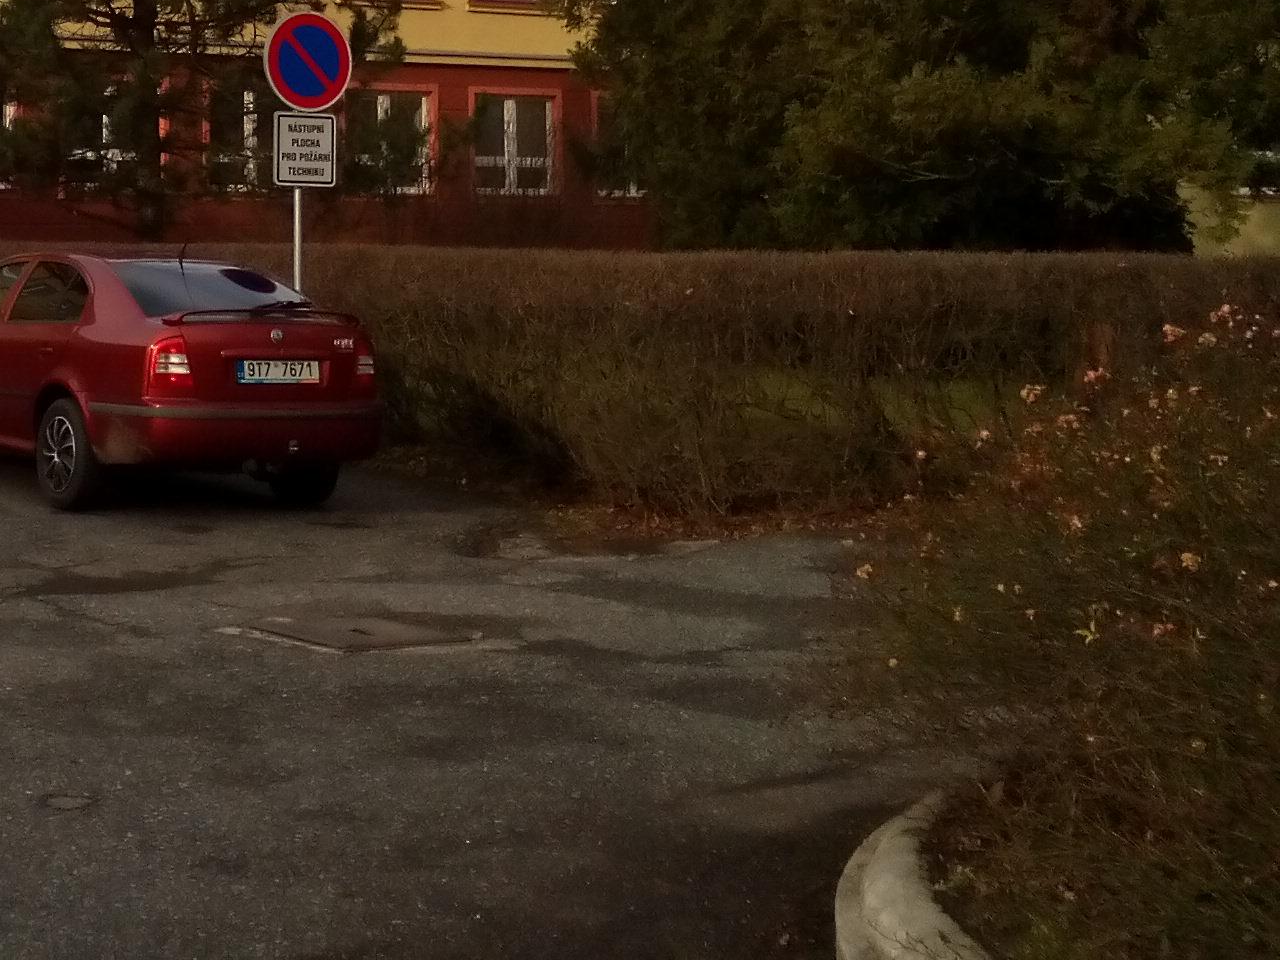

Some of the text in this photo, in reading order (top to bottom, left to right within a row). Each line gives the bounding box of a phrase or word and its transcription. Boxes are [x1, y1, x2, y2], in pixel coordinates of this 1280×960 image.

[291, 138, 320, 147] PLOCHA
[281, 150, 330, 162] PRO POŽÁRNÍ
[288, 166, 324, 176] TECHNIKU
[247, 362, 313, 377] 9T7 7671
